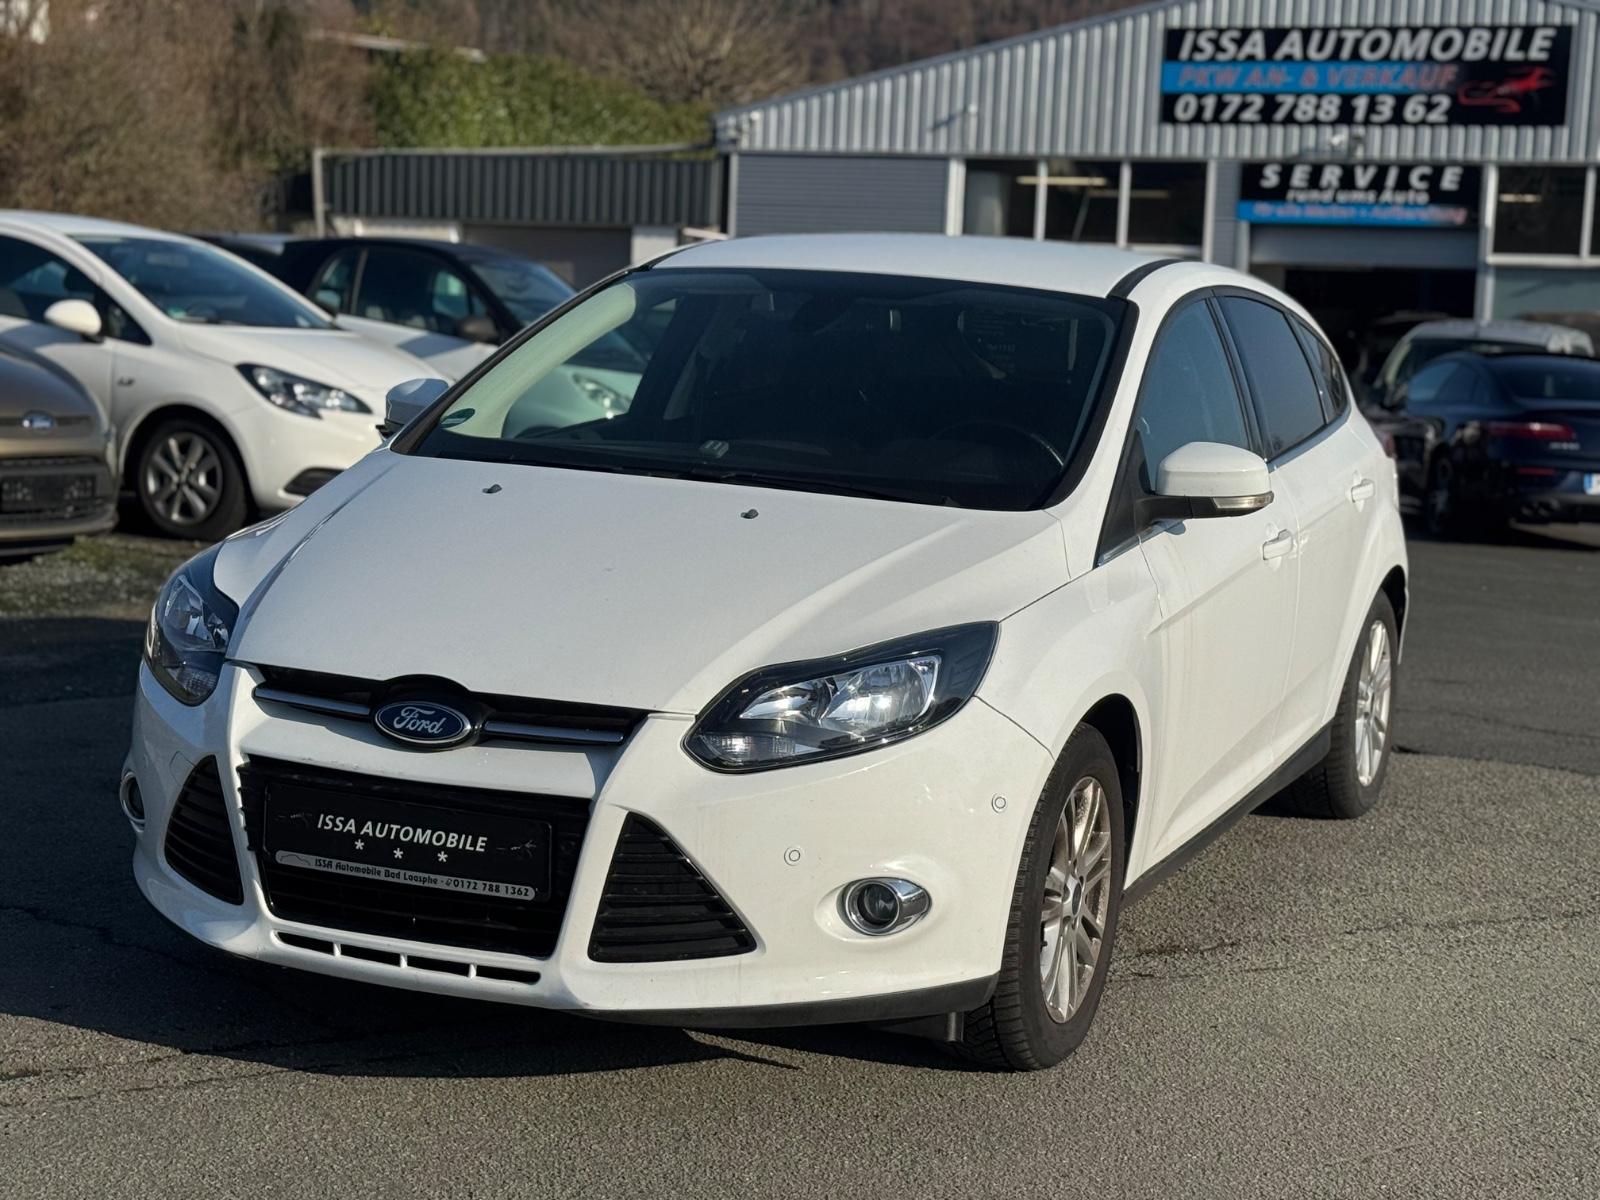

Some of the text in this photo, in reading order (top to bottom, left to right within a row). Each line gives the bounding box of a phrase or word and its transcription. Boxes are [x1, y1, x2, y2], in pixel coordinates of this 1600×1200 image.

[1178, 28, 1557, 62] ISSA AUTOMOBILE
[1178, 64, 1242, 88] PKW
[1243, 65, 1293, 88] AN-
[1327, 64, 1459, 89] VERKAUF
[1173, 93, 1452, 124] 0172 788 13 62
[393, 706, 447, 734] Ford
[317, 813, 488, 852] ISSA AUTOMOBILE
[314, 858, 529, 897] ISSA Automobile Bad Laasphe 0172 788 1362
